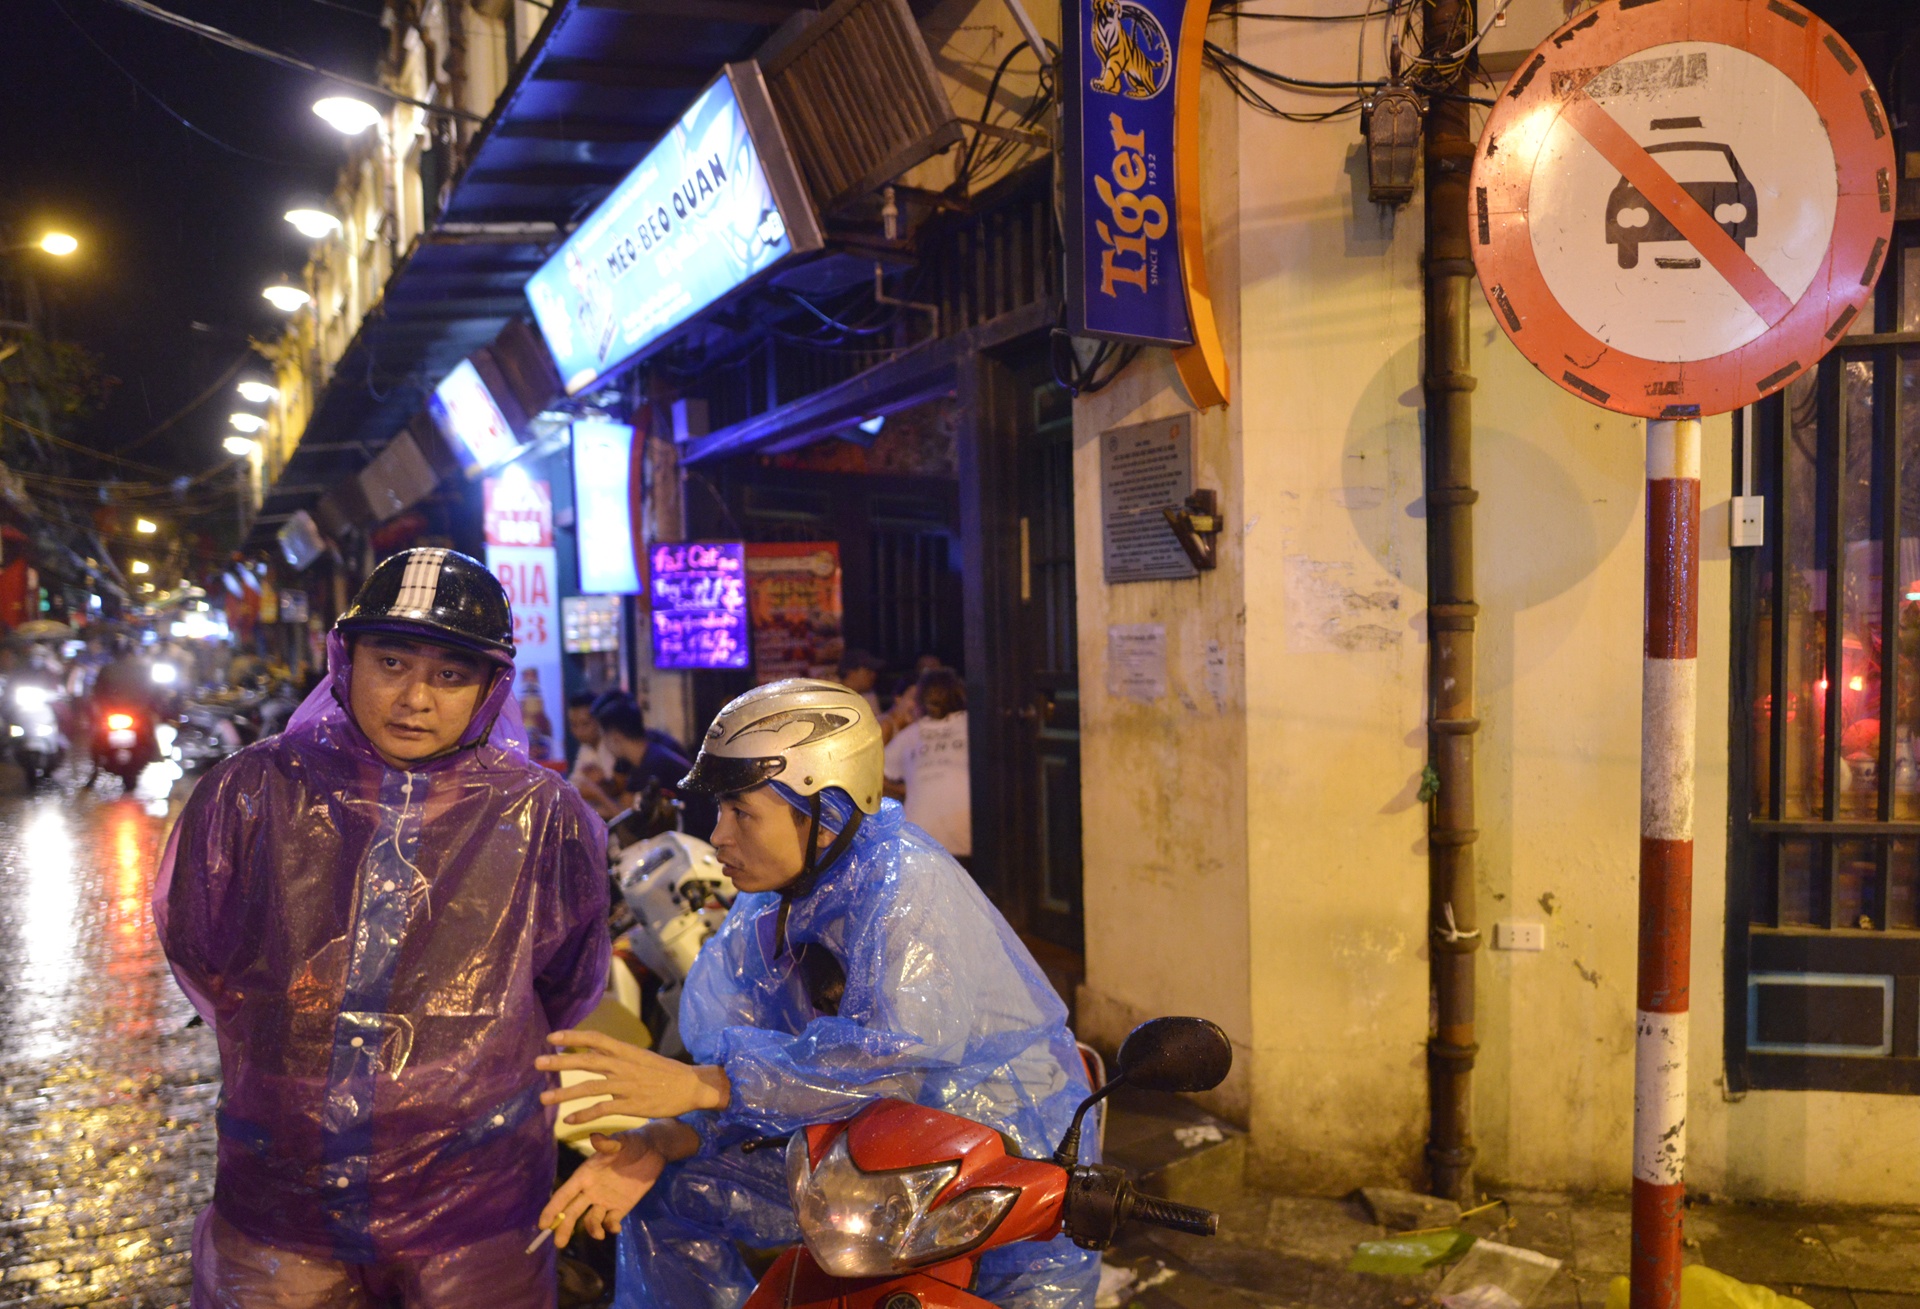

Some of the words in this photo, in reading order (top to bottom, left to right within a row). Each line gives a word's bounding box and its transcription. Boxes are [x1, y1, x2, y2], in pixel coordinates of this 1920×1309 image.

[1147, 153, 1157, 186] 1932
[1094, 112, 1169, 298] Tiger
[1150, 248, 1159, 285] SINCE
[497, 564, 551, 608] BIA
